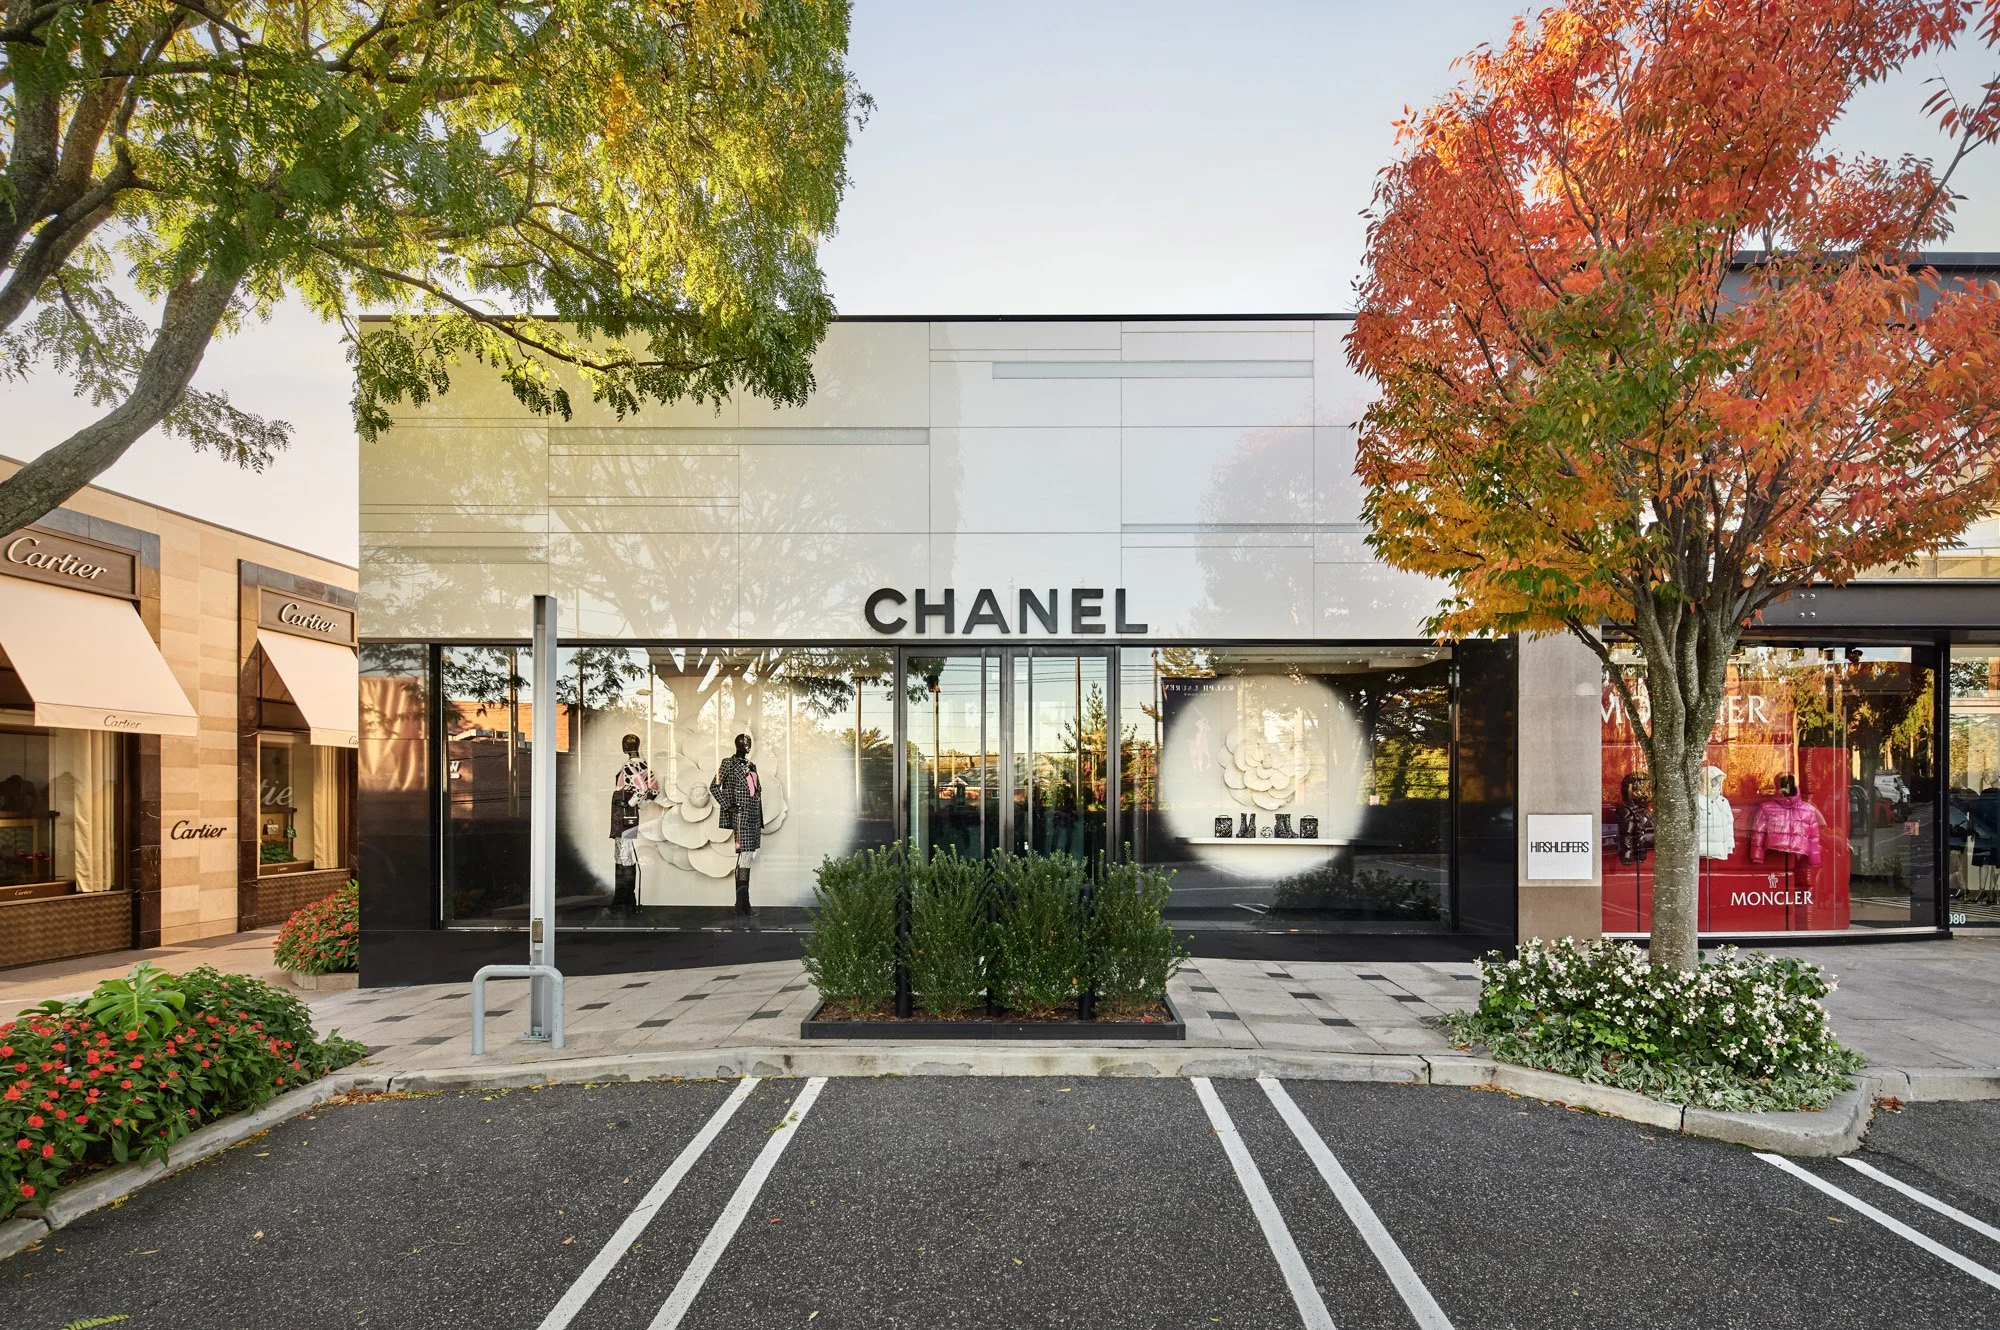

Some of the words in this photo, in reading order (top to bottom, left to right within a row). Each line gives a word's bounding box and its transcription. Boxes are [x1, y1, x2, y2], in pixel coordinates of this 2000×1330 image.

[7, 536, 107, 579] Cartier
[281, 602, 338, 632] Cartier
[864, 587, 1148, 634] CHANEL
[103, 714, 142, 729] Cartier
[170, 819, 228, 840] Cartier
[1530, 841, 1590, 853] HIRSHLEIFERS
[1730, 891, 1814, 906] MONCLER
